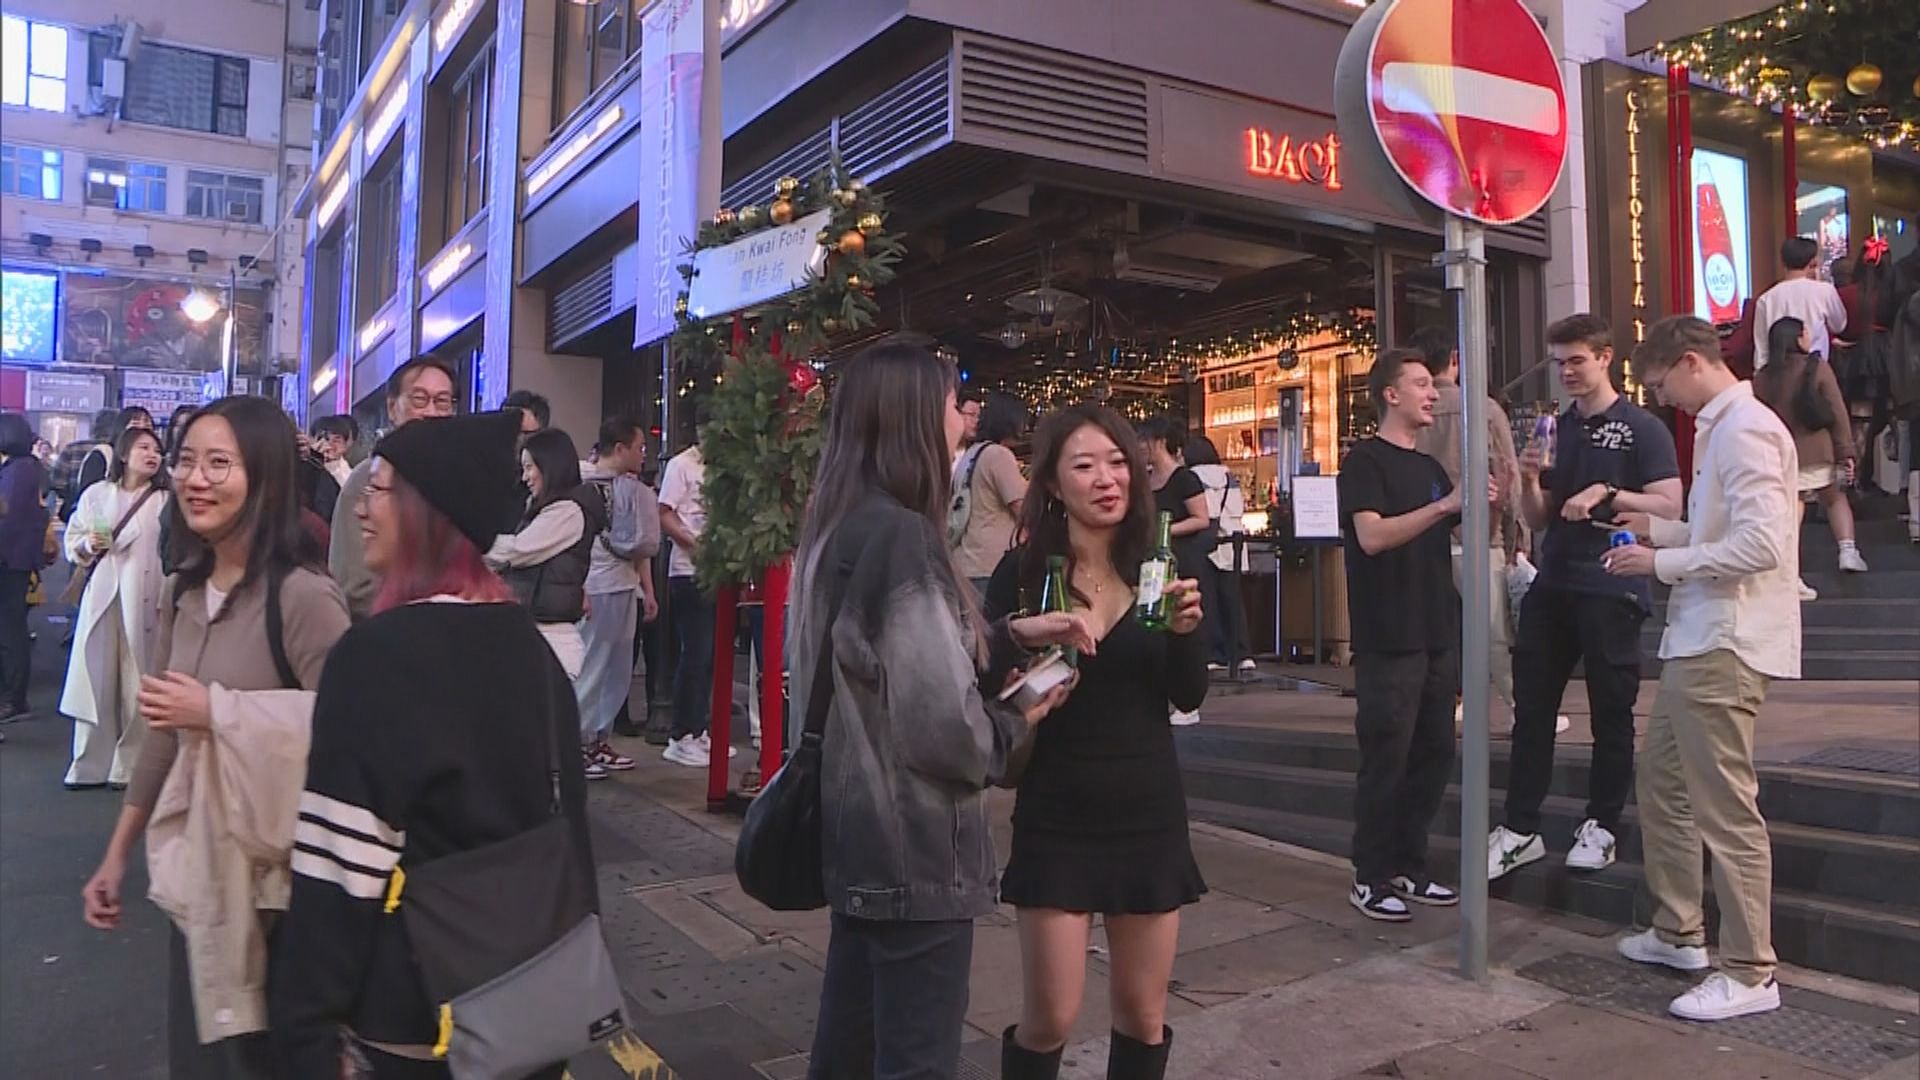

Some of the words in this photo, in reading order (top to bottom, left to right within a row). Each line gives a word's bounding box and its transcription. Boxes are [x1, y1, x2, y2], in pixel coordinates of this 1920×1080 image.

[749, 235, 776, 258] Kwai
[779, 228, 807, 249] Fong
[658, 199, 673, 318] KONG
[1602, 431, 1622, 449] 72
